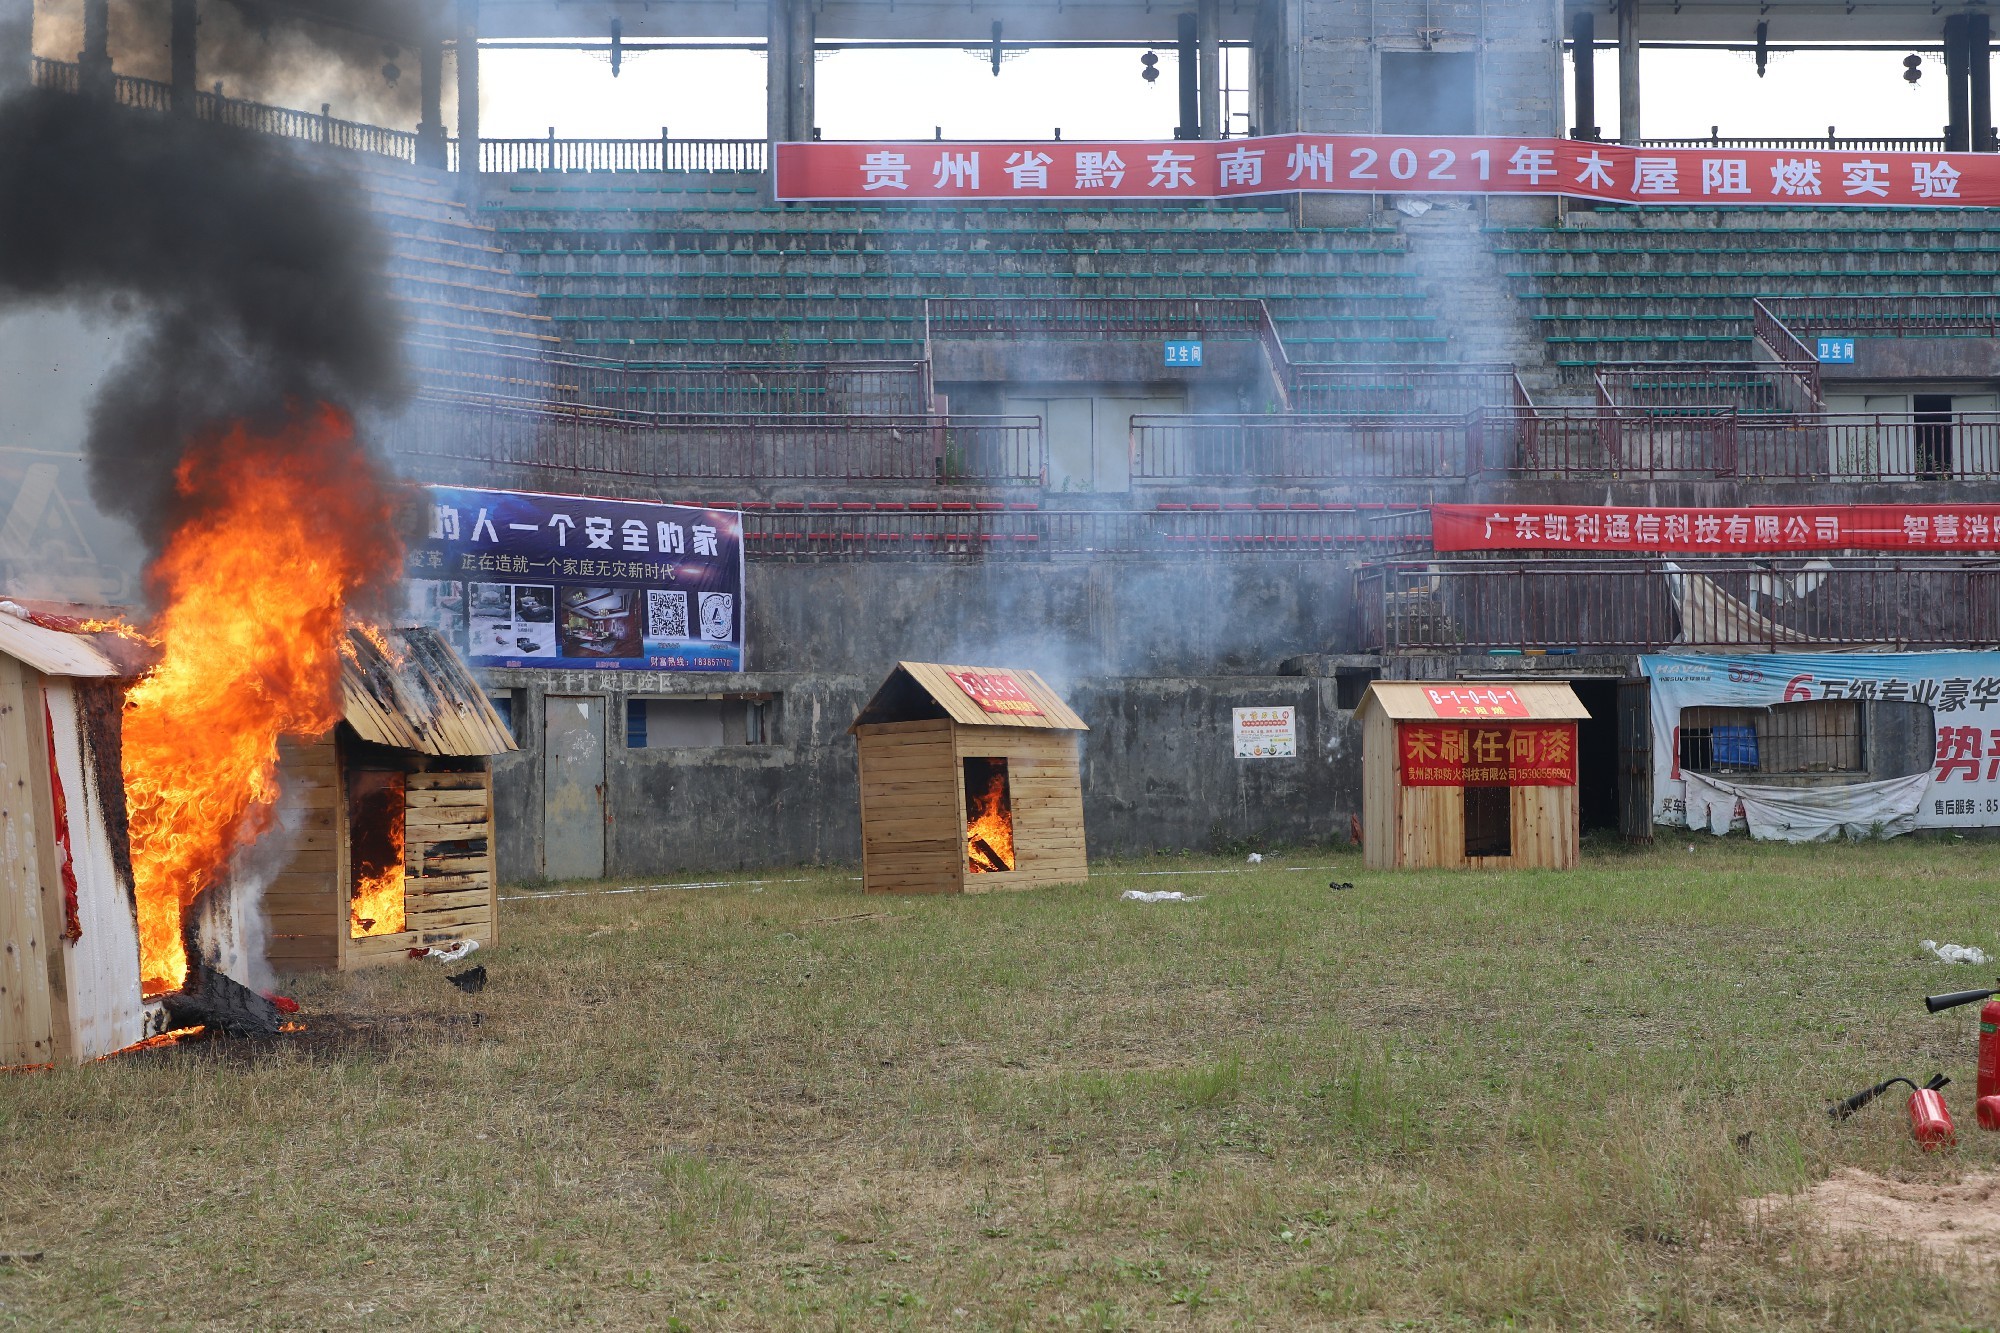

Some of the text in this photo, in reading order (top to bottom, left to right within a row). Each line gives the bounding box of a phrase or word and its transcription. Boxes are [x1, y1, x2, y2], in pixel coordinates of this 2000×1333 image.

[860, 143, 1961, 198] 贵州省黔东南州2021年木屋阻燃实验
[1166, 346, 1200, 361] 卫生间
[1820, 343, 1853, 358] 卫生间
[403, 504, 718, 556] 的人一个安全的家
[461, 552, 675, 580] 正在造就一个家庭无灾新时代
[1655, 664, 1714, 674] HAVAL
[1428, 689, 1518, 704] B-1-0-0-1
[1456, 706, 1506, 715] 不阻燃
[1407, 729, 1571, 763] 未刷任何漆
